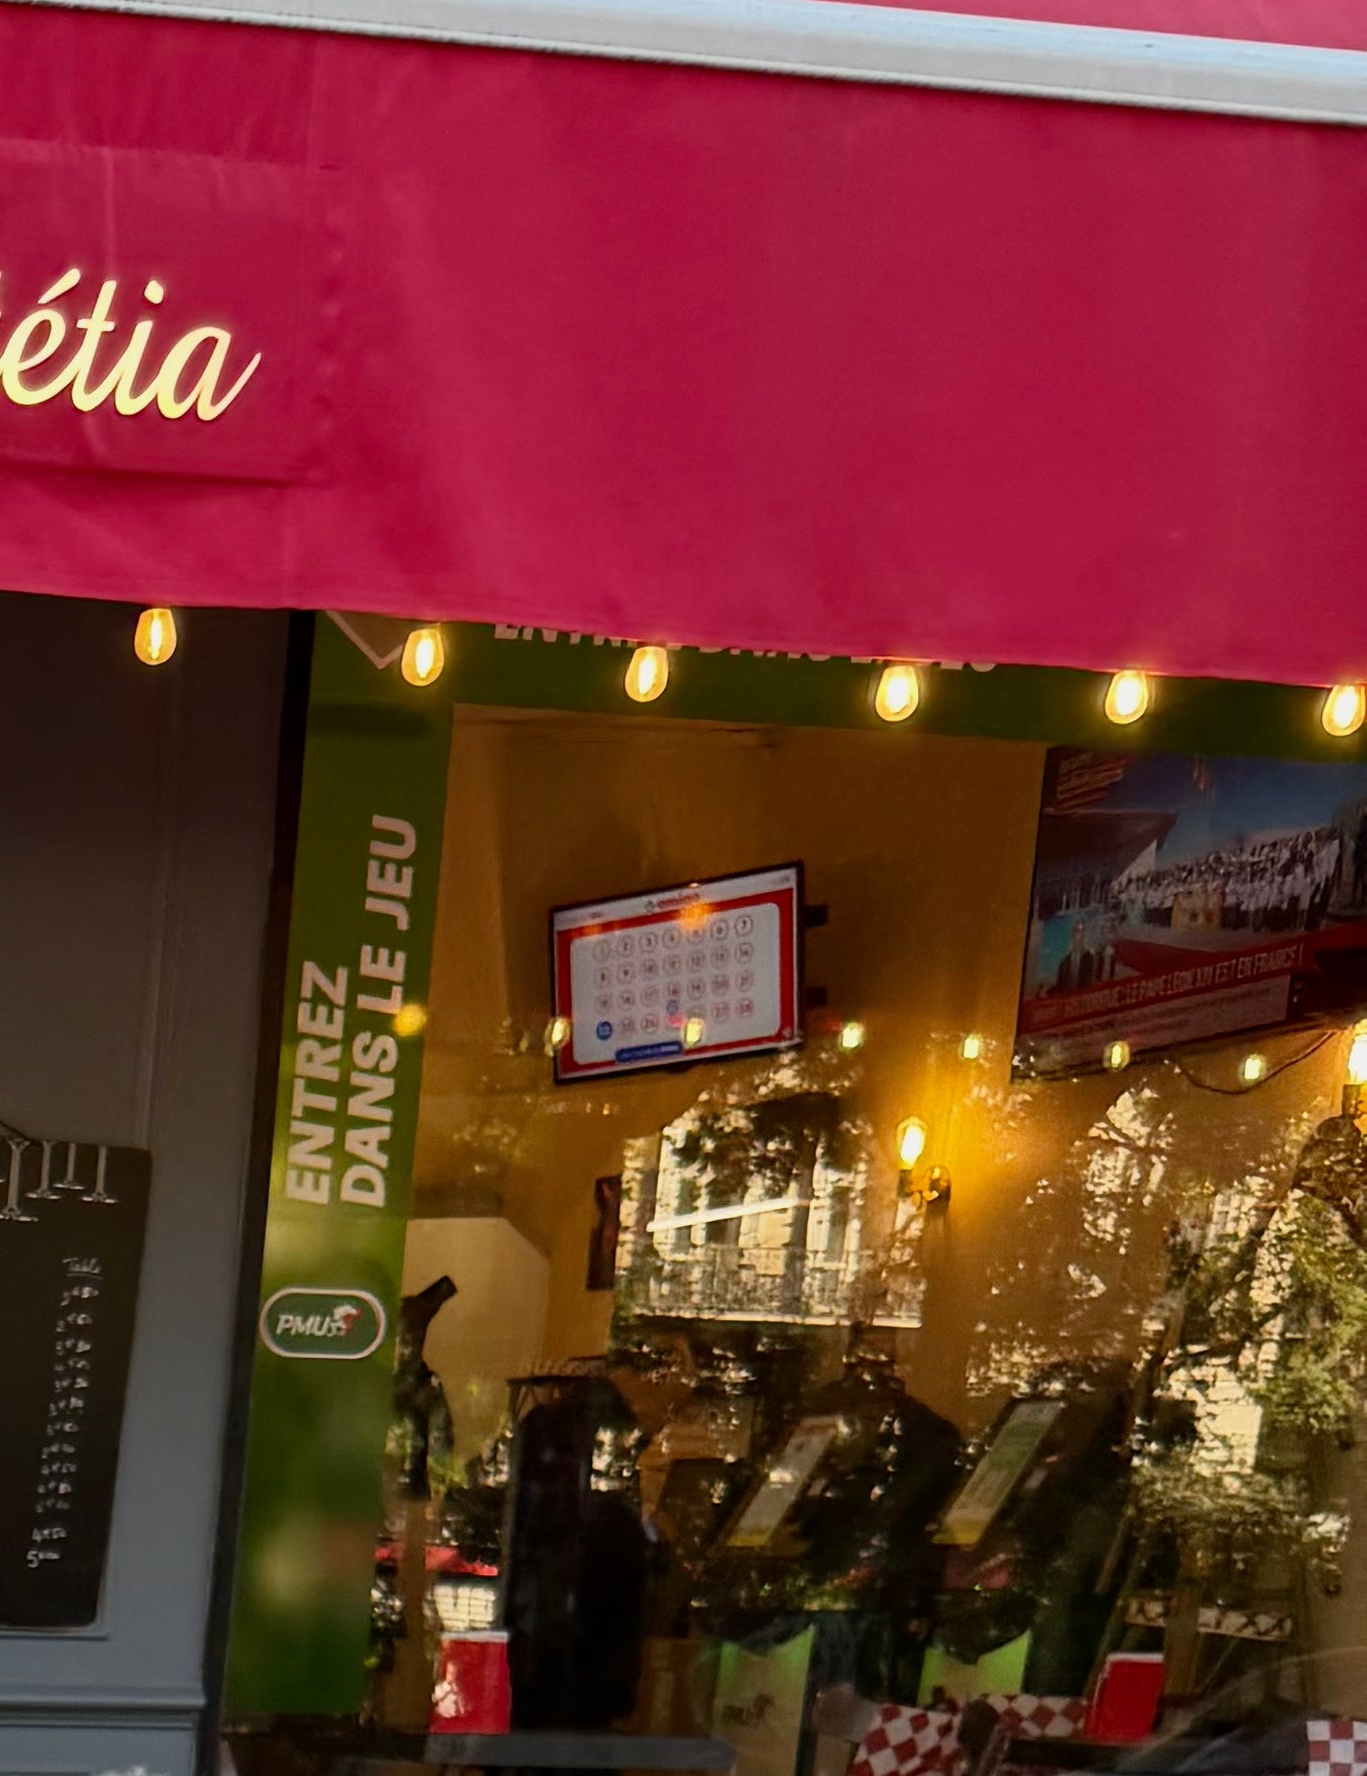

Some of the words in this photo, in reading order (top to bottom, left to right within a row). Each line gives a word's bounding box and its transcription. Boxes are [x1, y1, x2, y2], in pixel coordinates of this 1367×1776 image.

[365, 814, 417, 931] JEU
[357, 944, 408, 1015] LE
[284, 960, 349, 1206] ENTREZ
[339, 1030, 399, 1208] DANS
[275, 1313, 330, 1337] PMU
